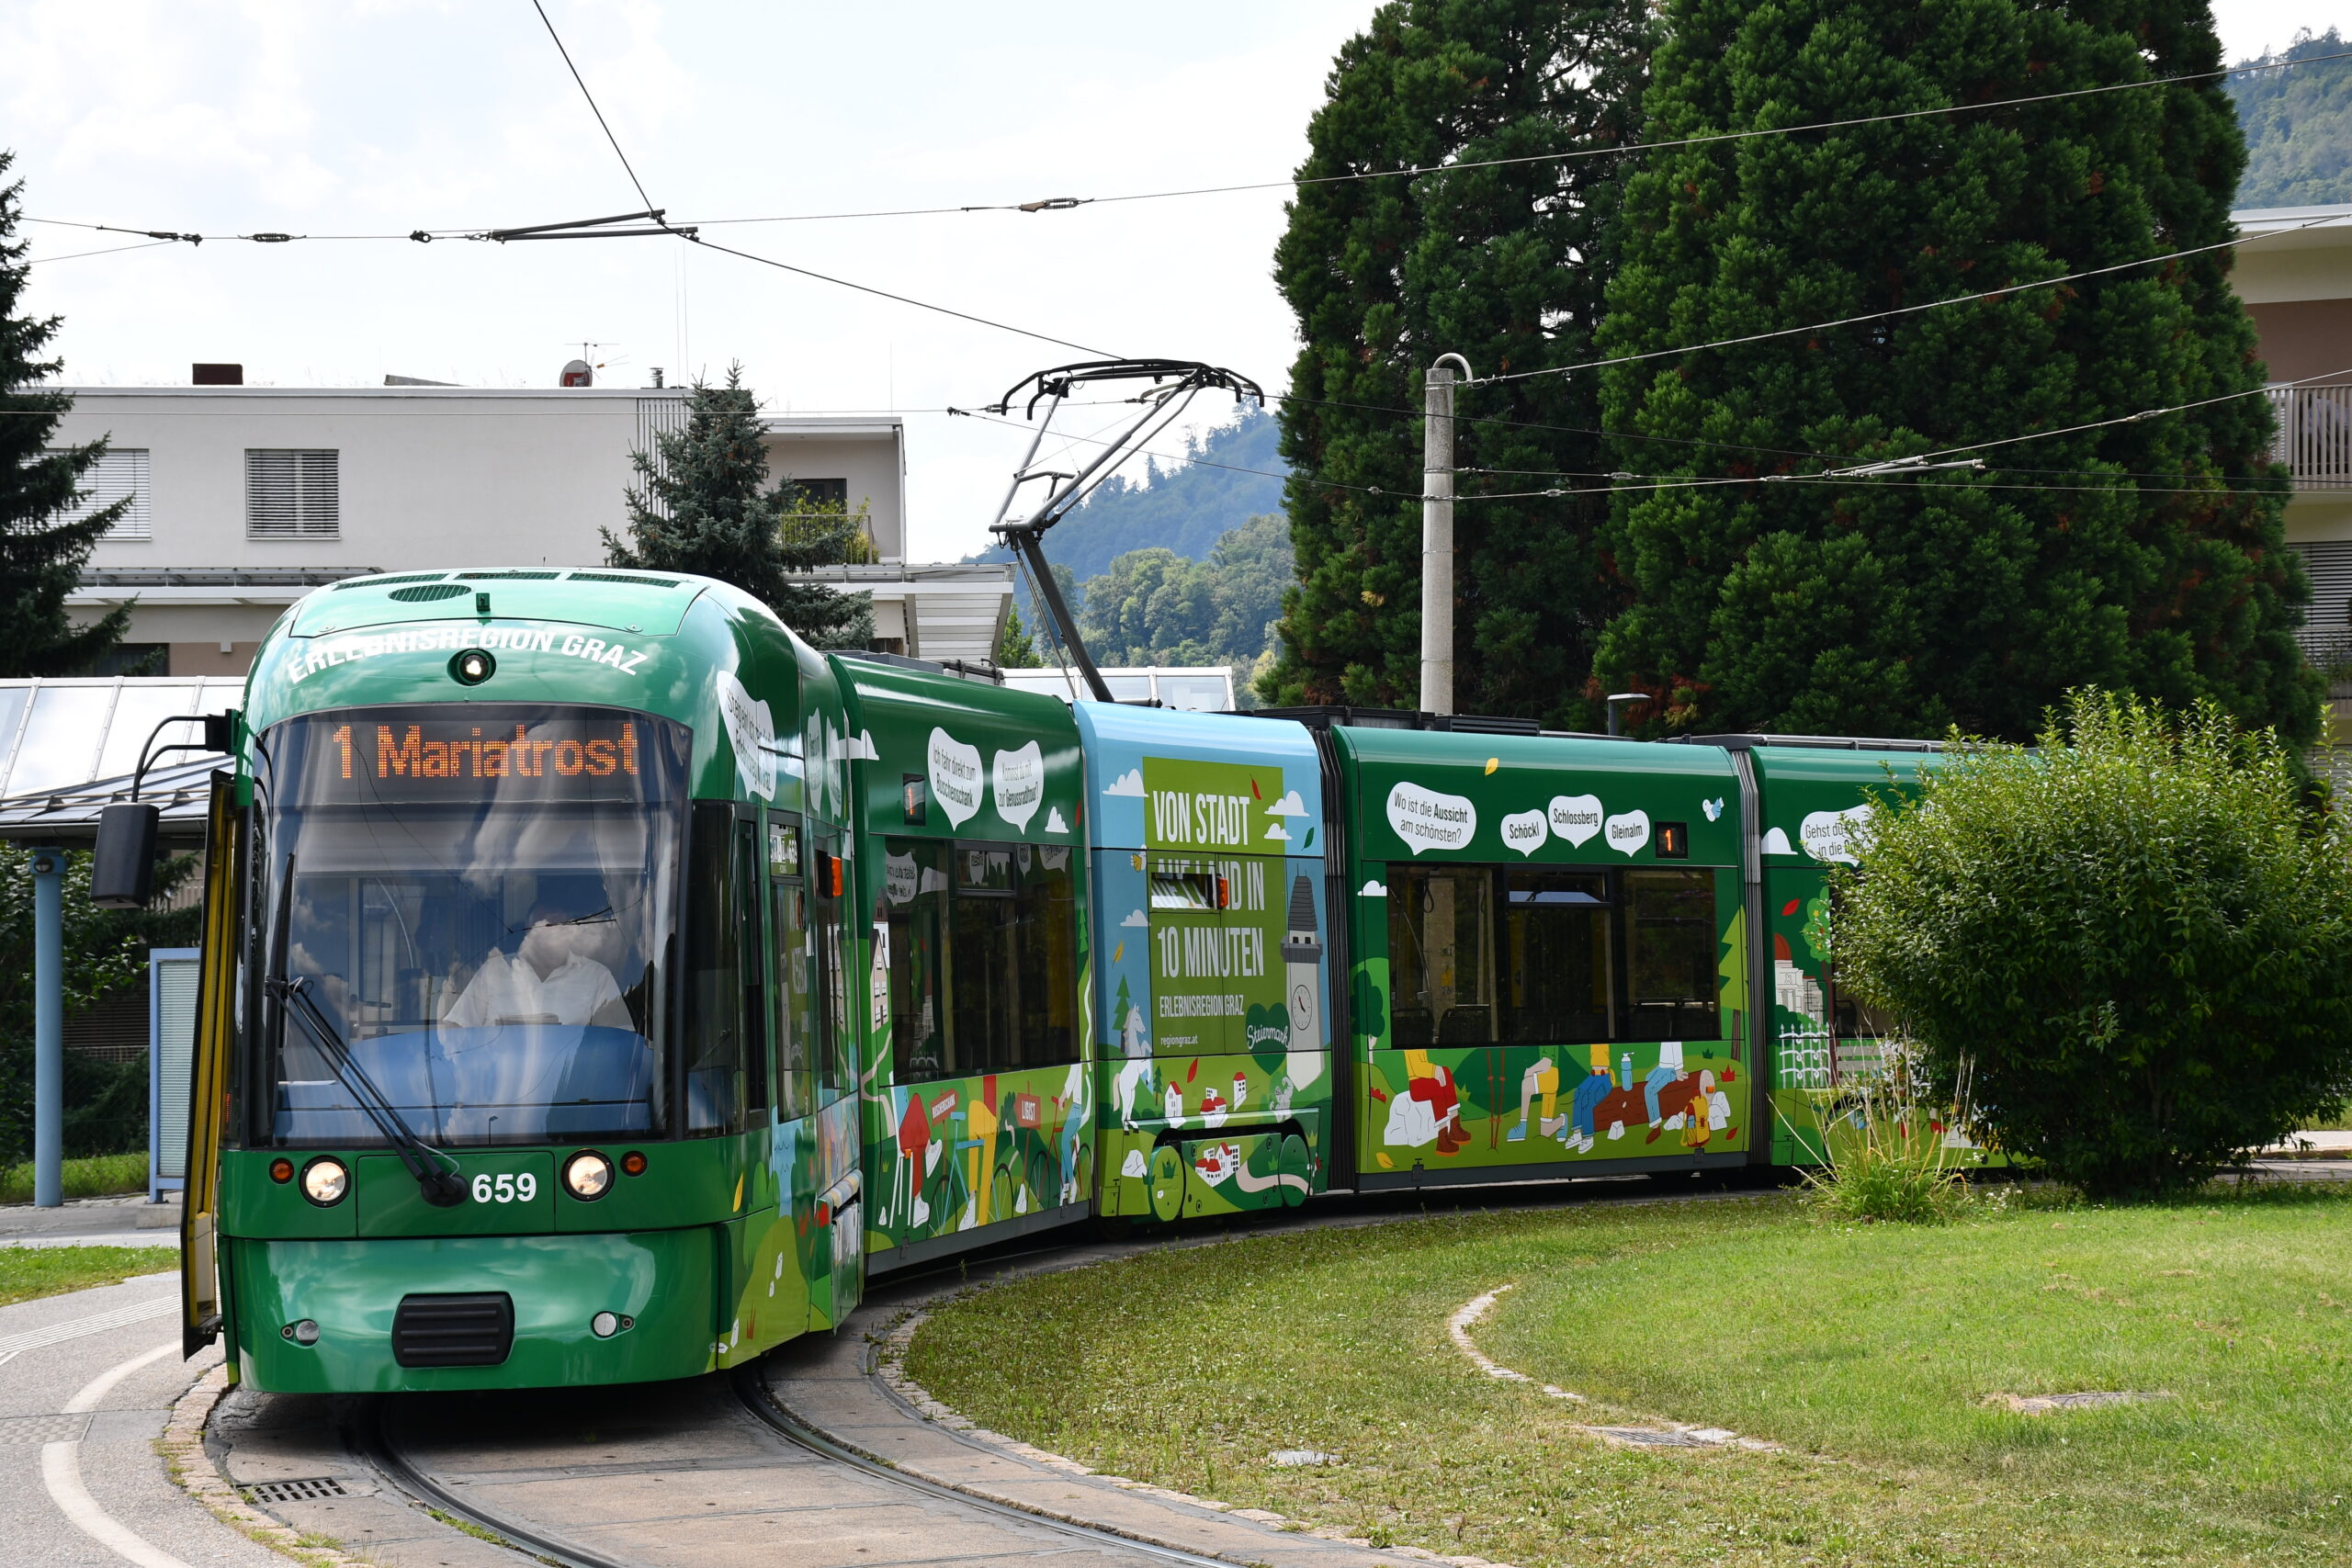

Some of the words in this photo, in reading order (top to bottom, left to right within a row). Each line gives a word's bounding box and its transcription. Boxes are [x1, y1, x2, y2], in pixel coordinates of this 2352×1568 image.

[287, 626, 553, 683] ERLEBNISREGION
[561, 633, 650, 676] GRAZ
[333, 725, 352, 779] 1
[378, 723, 639, 779] Mariatrost
[933, 742, 941, 766] Ich
[941, 749, 952, 773] fahr
[951, 752, 967, 778] direkt
[966, 766, 977, 782] zum
[1001, 761, 1019, 782] Kommst
[1019, 761, 1025, 780] du
[998, 792, 1006, 807] zur
[1394, 791, 1407, 810] Wo
[1408, 796, 1419, 817] ist
[1419, 800, 1432, 818] die
[1433, 803, 1468, 824] Aussicht
[1152, 790, 1192, 843] VON
[1195, 793, 1250, 846] STADT
[1553, 807, 1599, 828] Schlossberg
[1400, 818, 1414, 834] am
[1415, 821, 1463, 844] schönsten?
[1509, 821, 1540, 840] Schöckl
[1611, 823, 1644, 840] Gleinalm
[1664, 829, 1673, 852] 1
[1805, 824, 1831, 840] Gehst
[1832, 821, 1843, 837] du
[1817, 843, 1827, 857] in
[1828, 841, 1843, 856] die
[1246, 862, 1265, 911] IN
[1157, 925, 1181, 978] 10
[1183, 926, 1265, 977] MINUTEN
[1159, 994, 1224, 1018] ERLEBNISREGION
[1224, 994, 1245, 1016] GRAZ
[1160, 1033, 1199, 1048] regiongraz.at
[1246, 1024, 1291, 1050] Steiermark
[1022, 1100, 1036, 1122] LIGIST
[471, 1172, 537, 1203] 659
